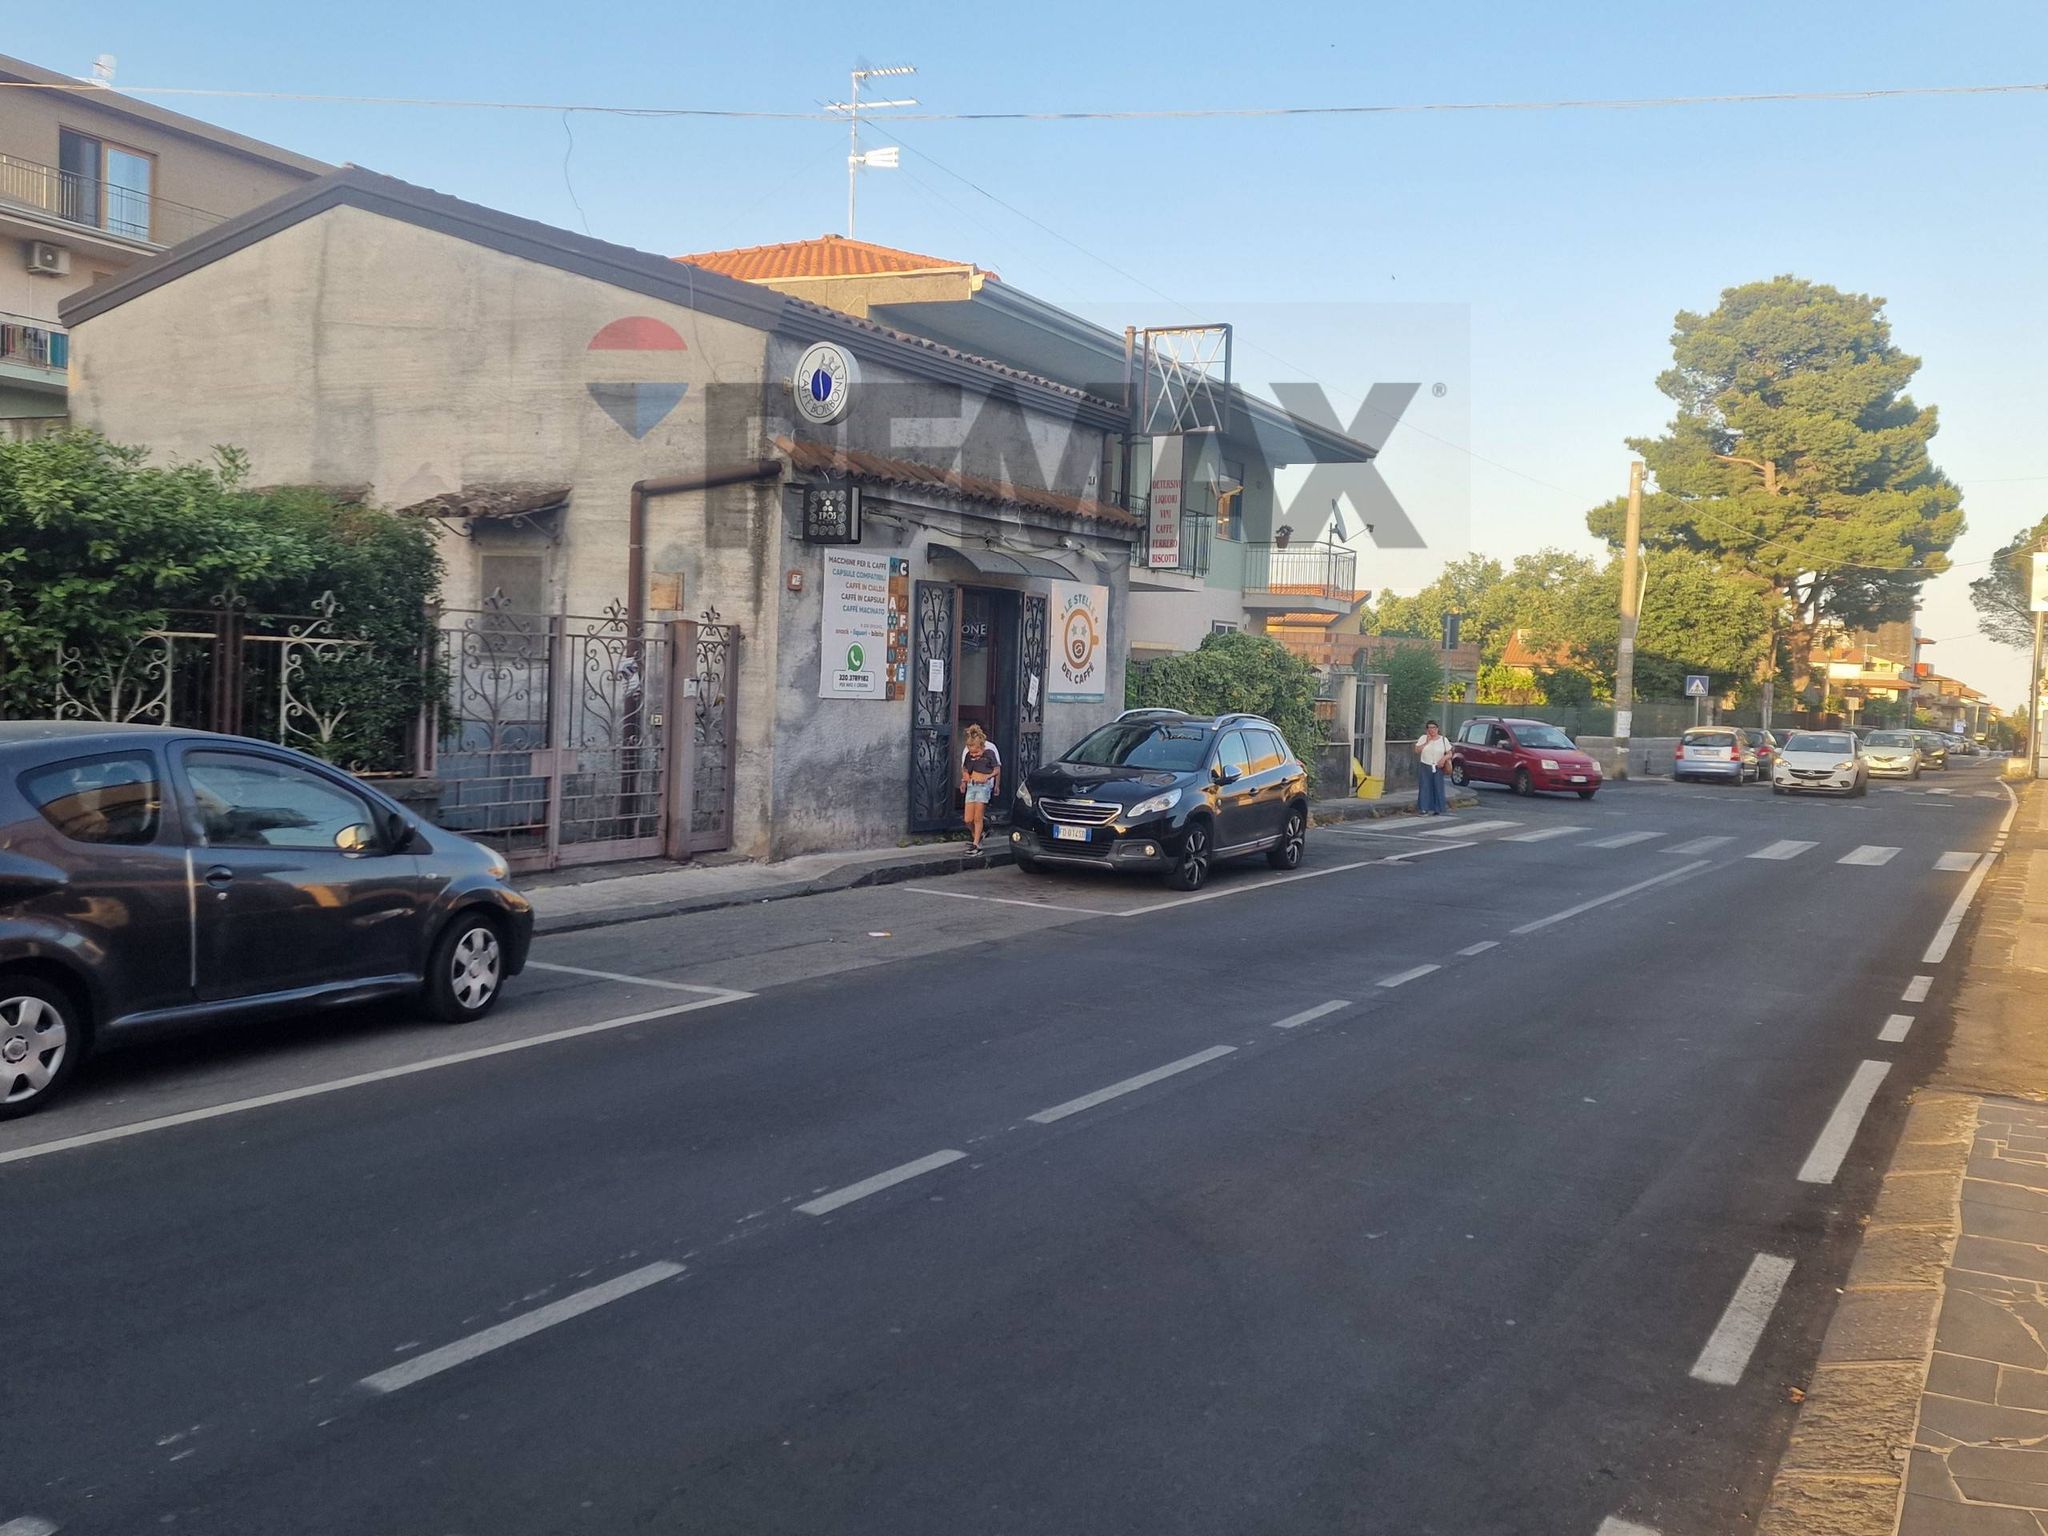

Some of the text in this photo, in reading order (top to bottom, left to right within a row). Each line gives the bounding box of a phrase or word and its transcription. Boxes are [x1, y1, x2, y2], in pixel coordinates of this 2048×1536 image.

[810, 374, 844, 416] BORBONE
[1154, 494, 1178, 505] LIQUORI
[1159, 509, 1172, 519] VINI
[1152, 538, 1178, 549] FERRERO
[828, 556, 856, 567] MACCHINE
[856, 560, 867, 568] PER
[1151, 553, 1178, 564] BISCOTTI
[832, 568, 856, 578] CAPSULE
[861, 583, 868, 591] IN
[857, 594, 864, 602] IN
[863, 595, 885, 605] CAPSULE
[1064, 598, 1073, 613] LE
[1060, 661, 1073, 682] DEL
